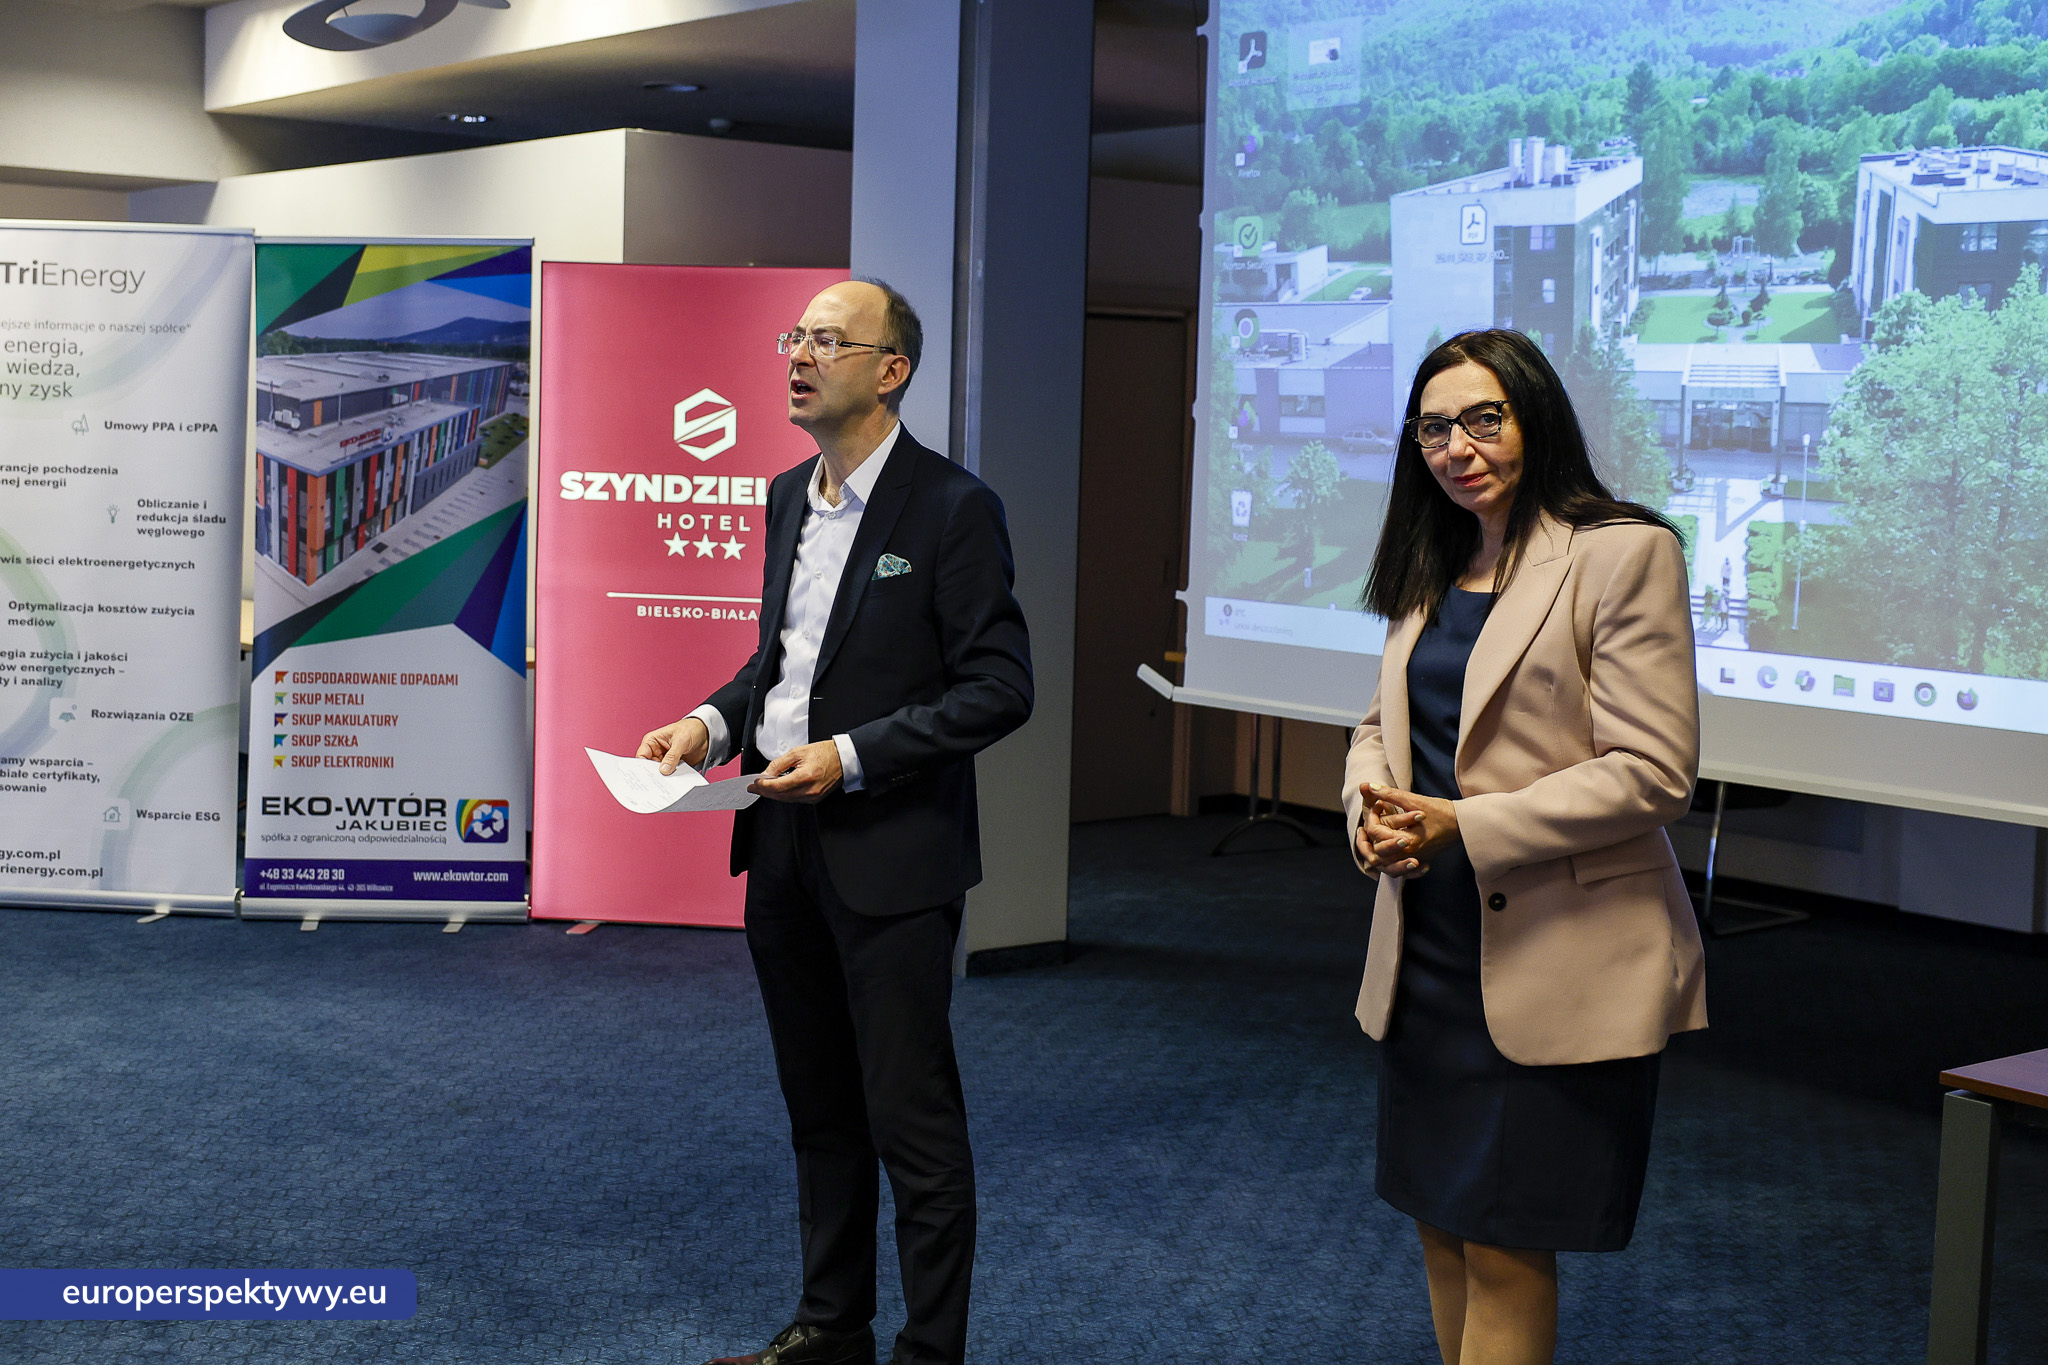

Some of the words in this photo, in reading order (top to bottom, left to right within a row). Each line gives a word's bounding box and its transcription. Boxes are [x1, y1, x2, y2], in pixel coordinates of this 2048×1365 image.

[0, 260, 146, 294] TriEnergy
[34, 318, 96, 333] informacje
[99, 323, 106, 331] o
[109, 322, 147, 334] naszej
[4, 338, 84, 358] energia,
[7, 359, 81, 378] wiedza,
[30, 381, 73, 400] zysk
[104, 420, 149, 433] Umowy
[152, 422, 176, 432] PPA
[179, 422, 183, 431] i
[187, 423, 219, 433] cPPA
[43, 465, 119, 475] pochodzenia
[24, 478, 67, 489] energii
[137, 499, 200, 510] Obliczanie
[203, 500, 207, 509] i
[136, 513, 189, 524] redukcja
[193, 514, 227, 525] śladu
[657, 513, 751, 531] HOTEL
[137, 527, 205, 539] węglowego
[26, 555, 55, 565] sieci
[58, 557, 196, 571] elektroenergetycznych
[8, 601, 94, 613] Optymalizacja
[98, 604, 148, 614] kosztów
[151, 605, 196, 617] zużycia
[637, 605, 759, 621] BIELSKO-BIAŁA
[8, 617, 56, 627] mediów
[30, 650, 74, 662] zużycia
[77, 651, 81, 660] i
[84, 652, 129, 663] jakości
[21, 664, 116, 676] energetycznych
[21, 676, 63, 689] analizy
[292, 671, 398, 686] GOSPODAROWANIE
[400, 673, 459, 686] ODPADAMI
[292, 693, 322, 706] SKUP
[324, 693, 365, 706] METALI
[91, 708, 166, 722] Rozwiązania
[169, 711, 194, 722] OZE
[291, 713, 322, 727] SKUP
[324, 714, 399, 727] MAKULATURY
[291, 734, 322, 747] SKUP
[324, 734, 359, 748] SZKŁA
[29, 757, 84, 768] wsparcia
[291, 754, 321, 768] SKUP
[324, 755, 395, 769] ELEKTRONIKI
[32, 771, 101, 784] certyfikaty,
[261, 793, 447, 817] EKO-WTÓR
[136, 808, 192, 821] Wsparcie
[195, 811, 221, 822] ESG
[336, 819, 447, 832] JAKUBIEC
[261, 833, 291, 843] spółka
[293, 834, 299, 842] z
[301, 833, 356, 844] ograniczoną
[358, 834, 448, 845] odpowiedzialnością
[259, 868, 280, 880] +48
[282, 868, 294, 880] 33
[296, 869, 316, 880] 443
[317, 869, 330, 880] 28
[331, 869, 345, 881] 30
[413, 869, 509, 882] www.ekowtor.com
